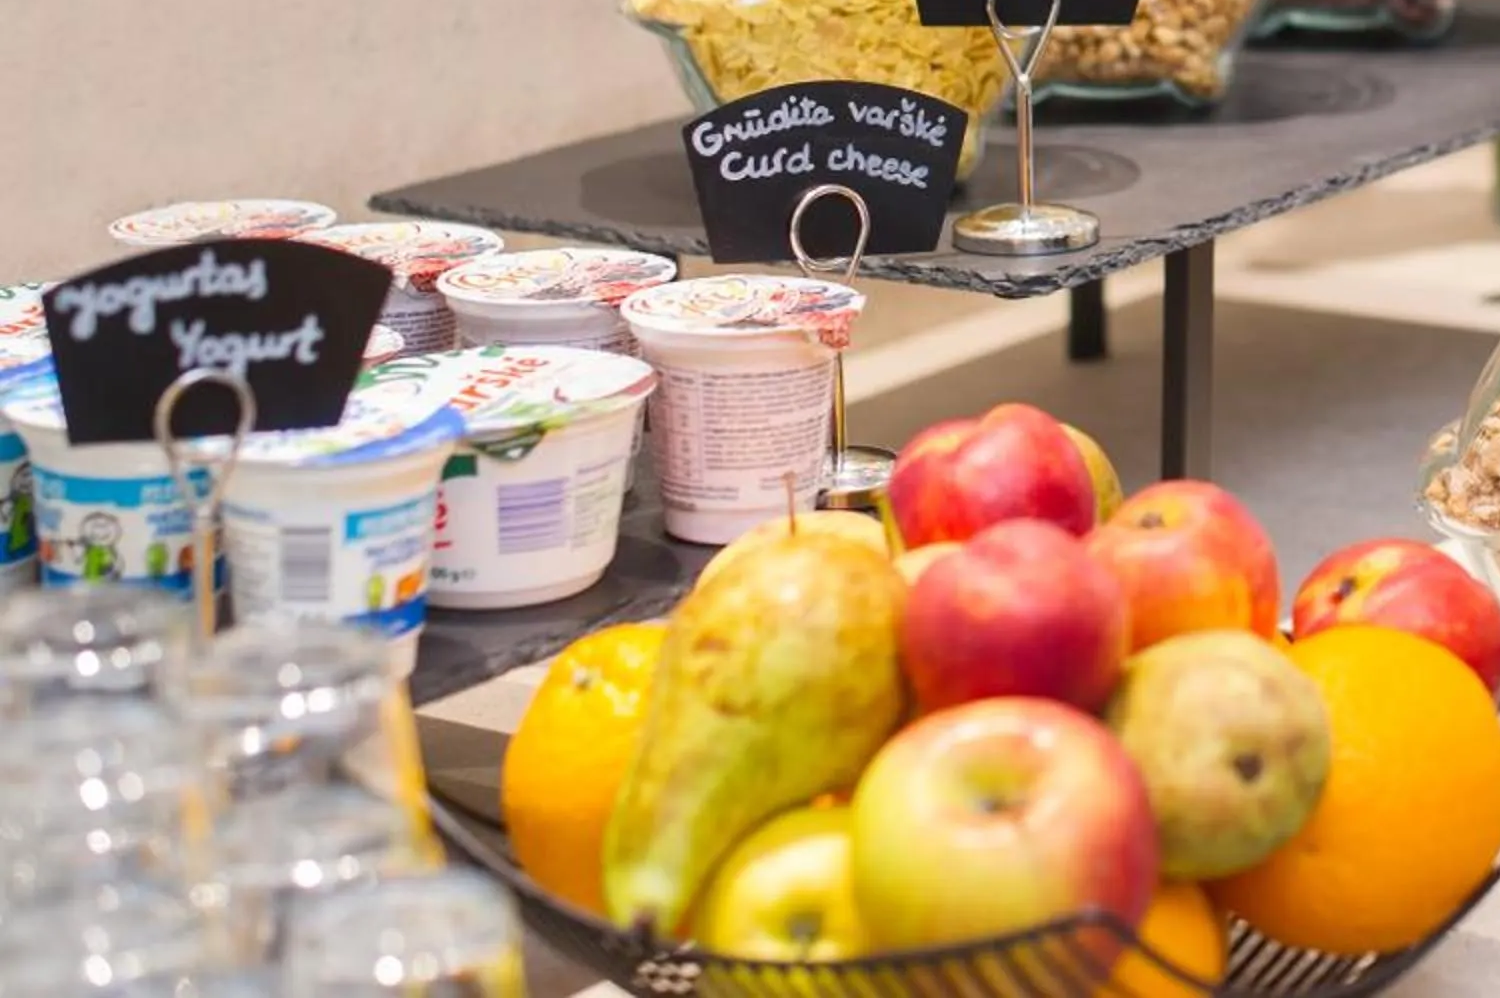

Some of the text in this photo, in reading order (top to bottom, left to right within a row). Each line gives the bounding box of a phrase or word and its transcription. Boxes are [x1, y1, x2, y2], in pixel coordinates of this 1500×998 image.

[719, 141, 930, 189] Curd cheese
[170, 312, 325, 376] Yogurt
